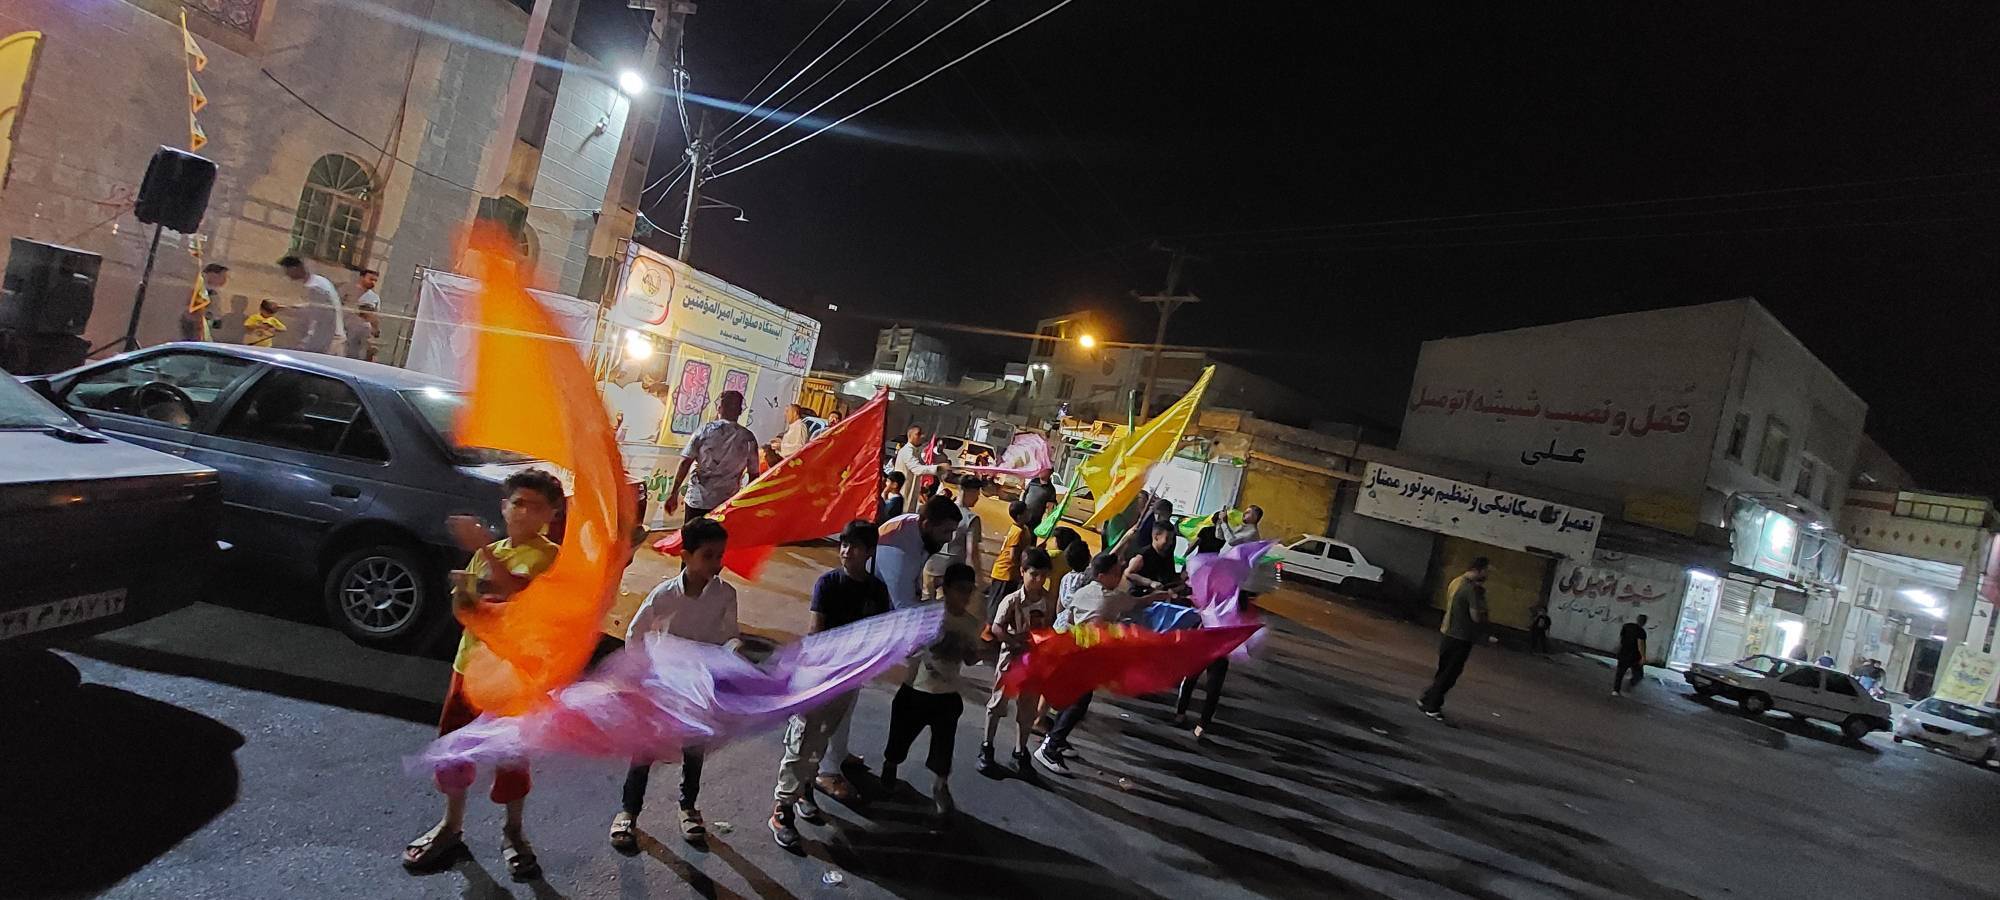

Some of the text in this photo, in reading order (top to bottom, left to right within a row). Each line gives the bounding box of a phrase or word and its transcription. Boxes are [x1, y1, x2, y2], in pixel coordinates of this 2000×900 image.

[731, 311, 759, 330] صلواتی
[757, 318, 784, 341] ایستگاه
[1472, 389, 1541, 423] شیشه
[1544, 399, 1611, 432] نصب
[1520, 439, 1586, 465] علی
[1365, 467, 1400, 489] ممتاز
[1399, 476, 1435, 500] موتور
